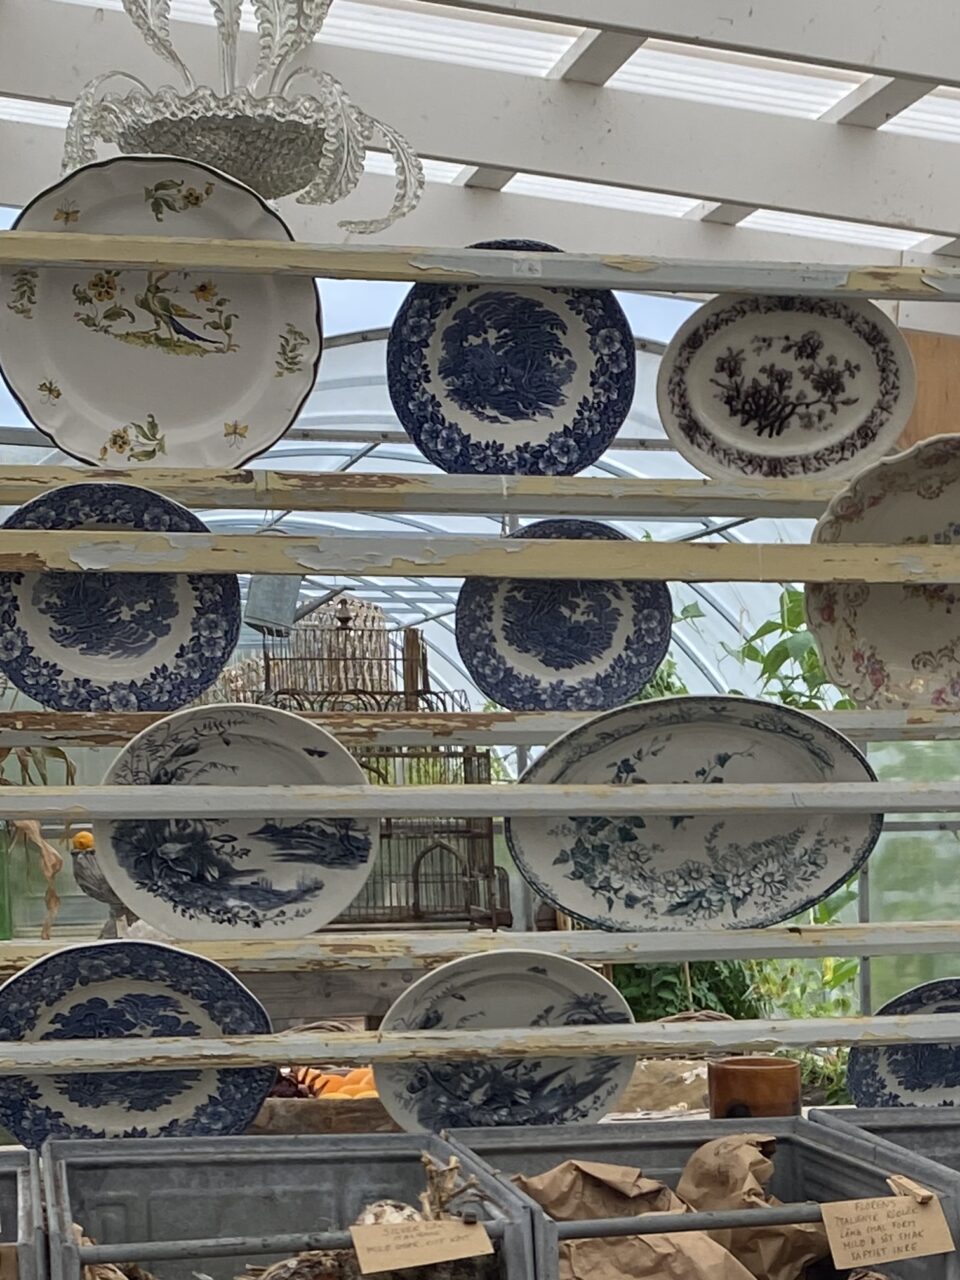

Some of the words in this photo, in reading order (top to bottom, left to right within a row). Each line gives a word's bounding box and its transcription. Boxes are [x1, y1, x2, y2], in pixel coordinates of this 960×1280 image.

[855, 1200, 897, 1212] FLORENS
[892, 1220, 916, 1230] FORM
[843, 1239, 866, 1250] MILD
[899, 1229, 924, 1241] SMAK
